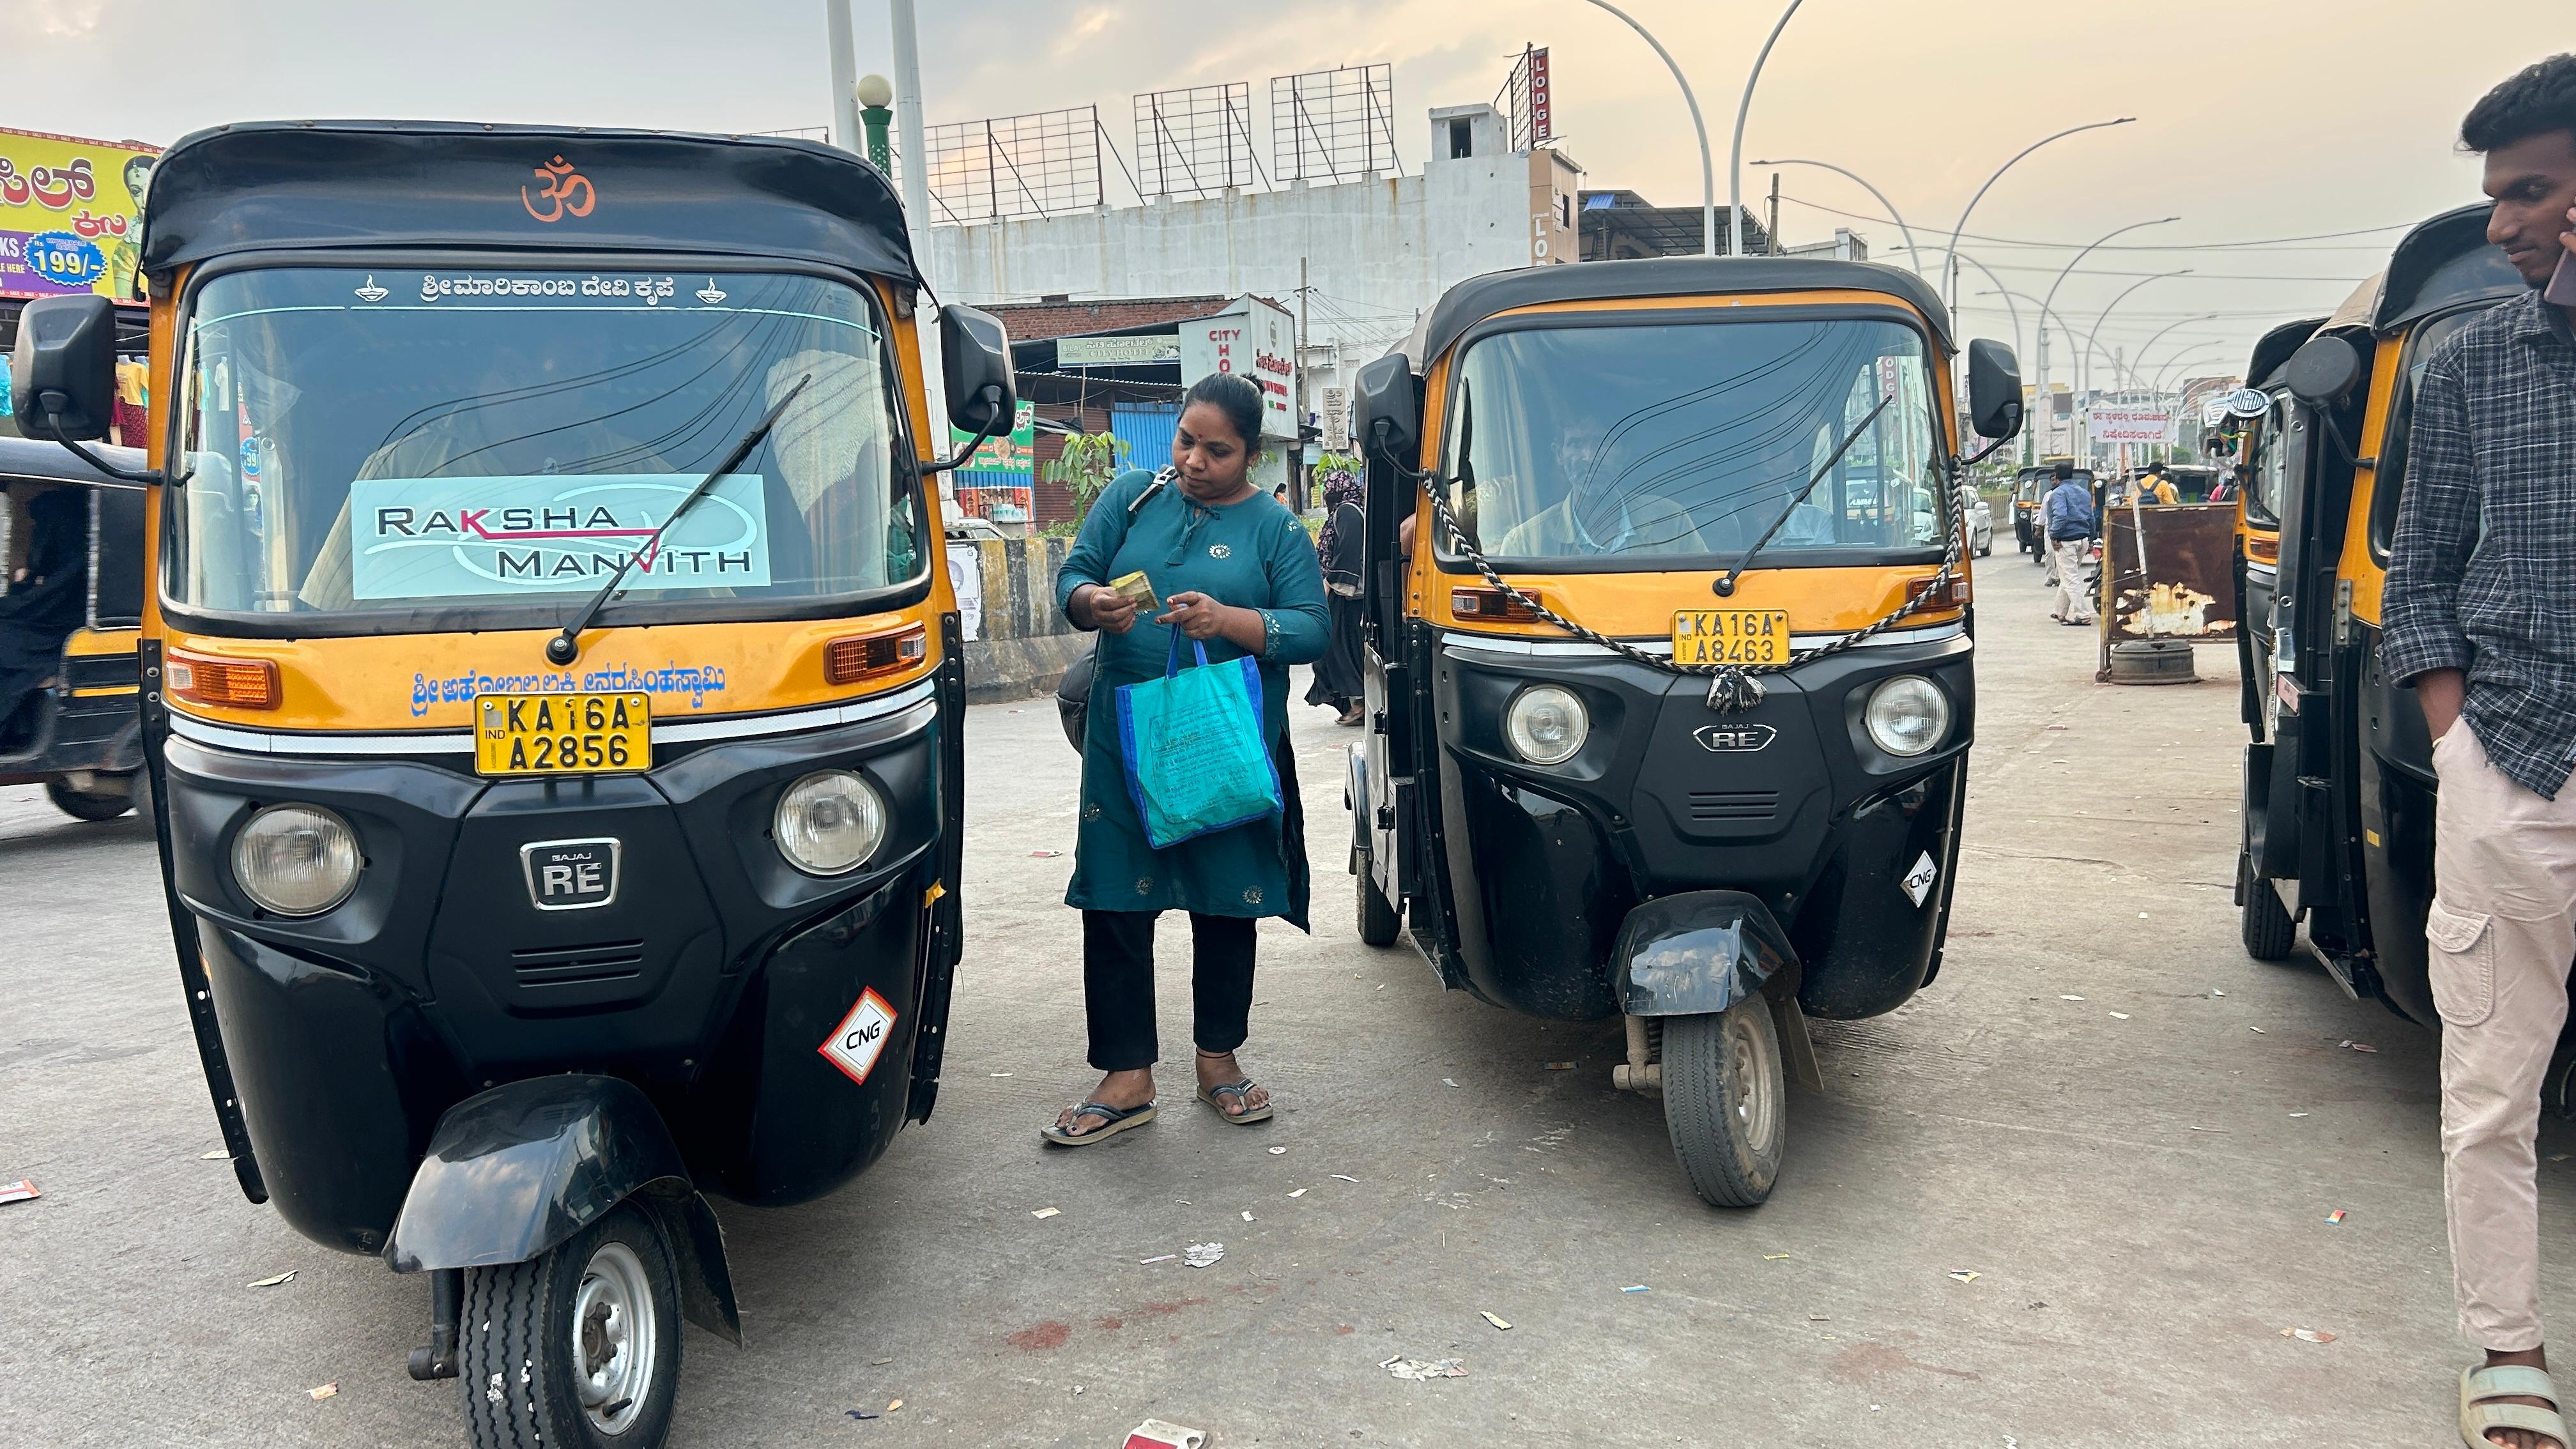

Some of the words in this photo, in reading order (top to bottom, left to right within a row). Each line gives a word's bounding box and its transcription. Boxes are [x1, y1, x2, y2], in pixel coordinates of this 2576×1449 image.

[1535, 60, 1547, 137] LODGE
[6, 263, 25, 273] HERE
[34, 249, 100, 277] 199/-
[581, 275, 630, 296] ದೇವಿ
[634, 276, 675, 305] ಕೃಪೆ
[1209, 330, 1241, 341] CITY
[1116, 348, 1149, 356] HOTEL
[378, 507, 620, 538] RAKSHA
[500, 550, 752, 578] MANVITH
[1695, 614, 1774, 636] KA16A
[1696, 640, 1774, 662] A8463
[411, 673, 438, 716] ಶ್ರೀ
[485, 730, 505, 739] IND
[1712, 732, 1758, 747] RE
[509, 735, 628, 769] A2856
[552, 852, 592, 862] BAJAJ
[543, 862, 604, 896] RE
[1910, 869, 1931, 888] CNG
[846, 1020, 880, 1050] CNG
